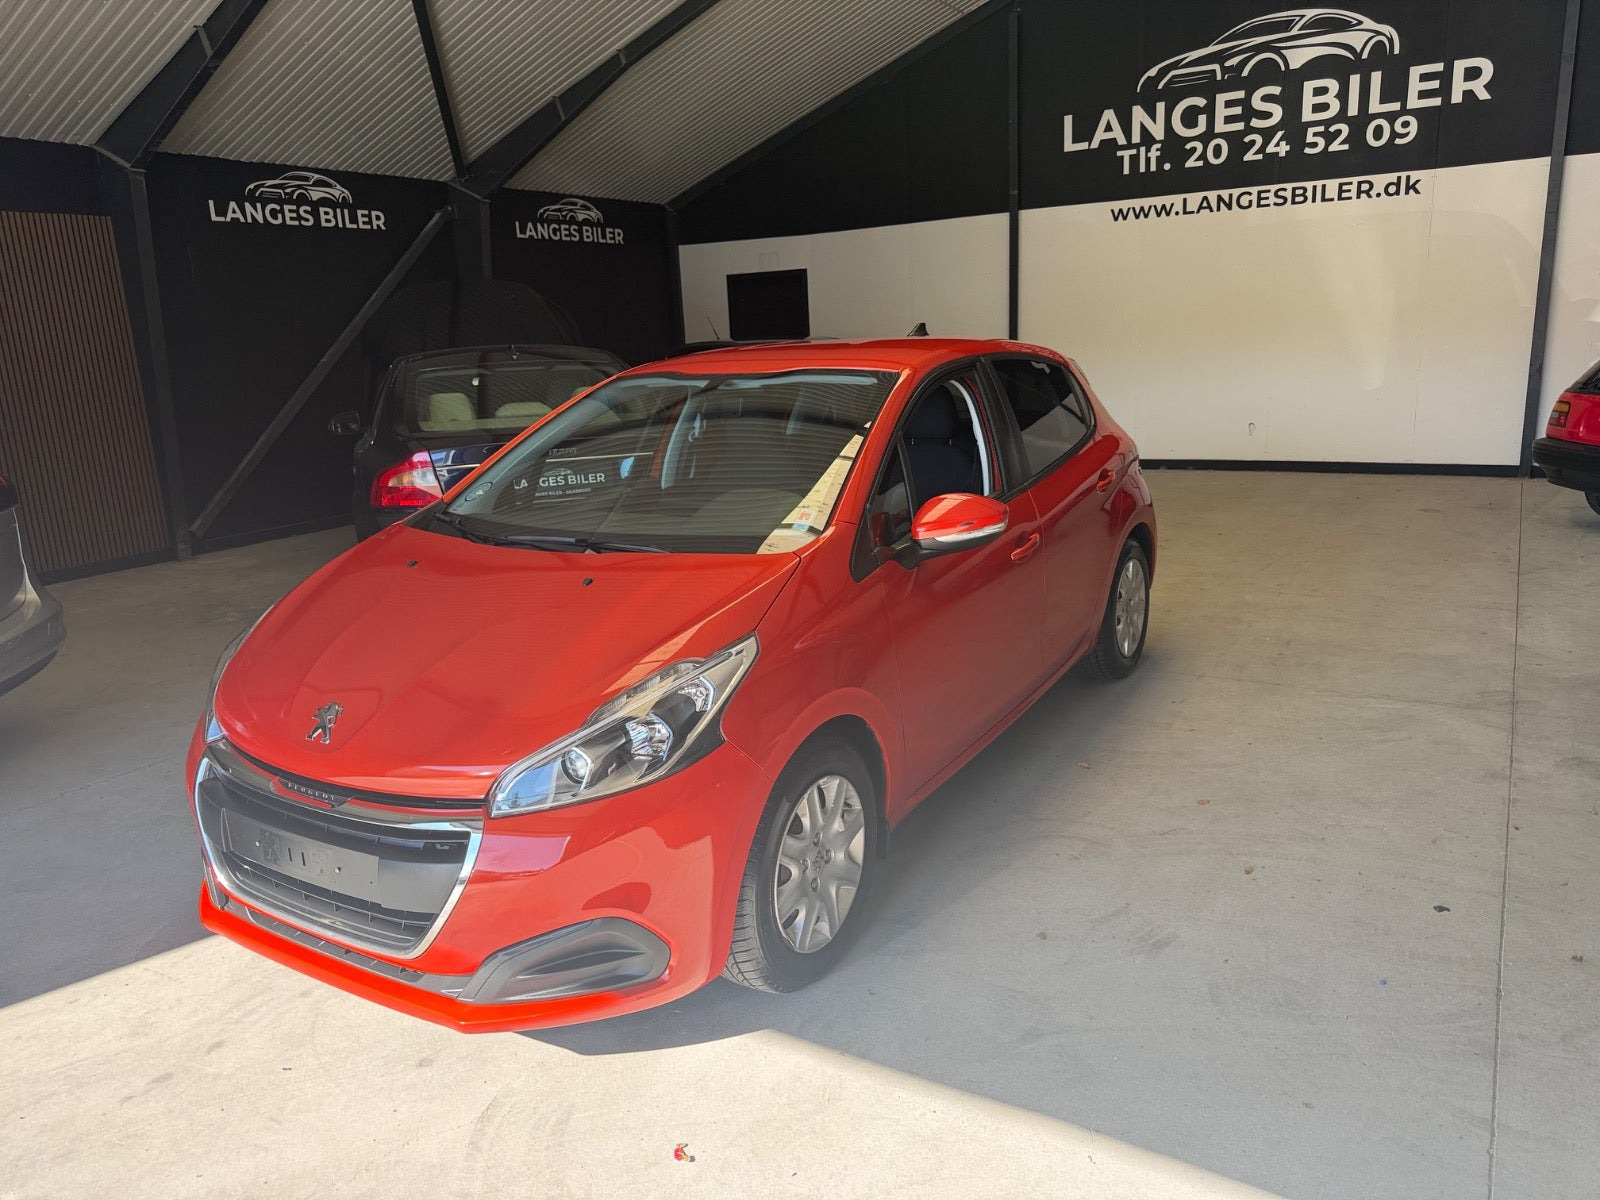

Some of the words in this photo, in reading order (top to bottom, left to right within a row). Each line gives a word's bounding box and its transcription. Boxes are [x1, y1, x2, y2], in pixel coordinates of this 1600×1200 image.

[1063, 86, 1283, 152] LANGES
[1301, 57, 1494, 122] BILER
[1116, 147, 1171, 175] Tlf.
[1184, 138, 1229, 168] 20
[1242, 130, 1290, 161] 24
[1303, 123, 1350, 154] 52
[1365, 115, 1418, 148] 09
[208, 199, 314, 226] LANGES
[320, 207, 386, 231] BILER
[1110, 175, 1422, 222] www.LANGESBILER.dk
[515, 221, 579, 242] LANGES
[582, 226, 624, 244] BILER
[513, 475, 565, 489] LAGES
[568, 473, 605, 484] BILER
